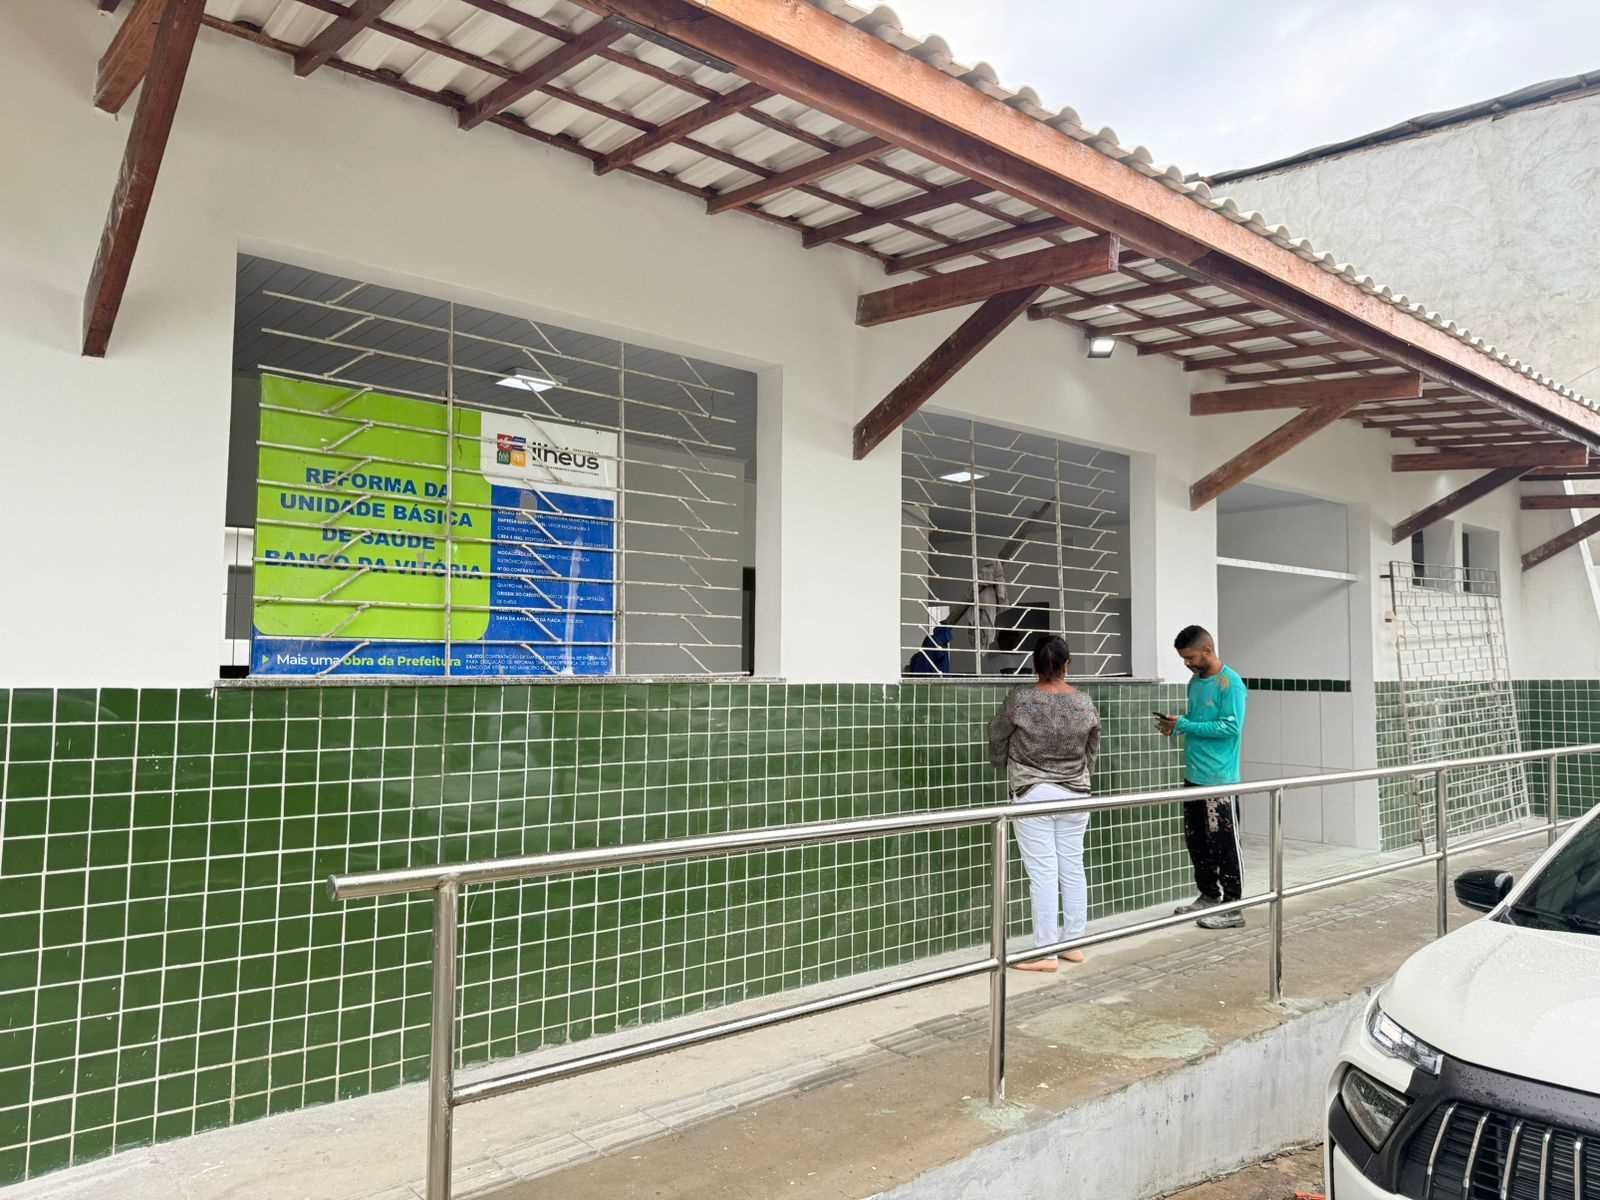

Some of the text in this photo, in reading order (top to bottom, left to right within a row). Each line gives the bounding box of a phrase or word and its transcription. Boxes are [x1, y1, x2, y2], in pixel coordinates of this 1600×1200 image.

[305, 467, 452, 499] REFORMA DA
[280, 492, 386, 519] UNIDADE
[393, 503, 473, 528] BÁSICA
[322, 526, 436, 550] DE SAÚDE
[264, 550, 350, 569] BANCO
[357, 556, 388, 574] DA
[395, 558, 483, 580] VITÓRIA
[276, 654, 308, 666] Mais
[309, 656, 342, 666] uma
[343, 655, 374, 666] obra
[377, 655, 394, 667] da
[397, 655, 462, 667] Prefeitura
